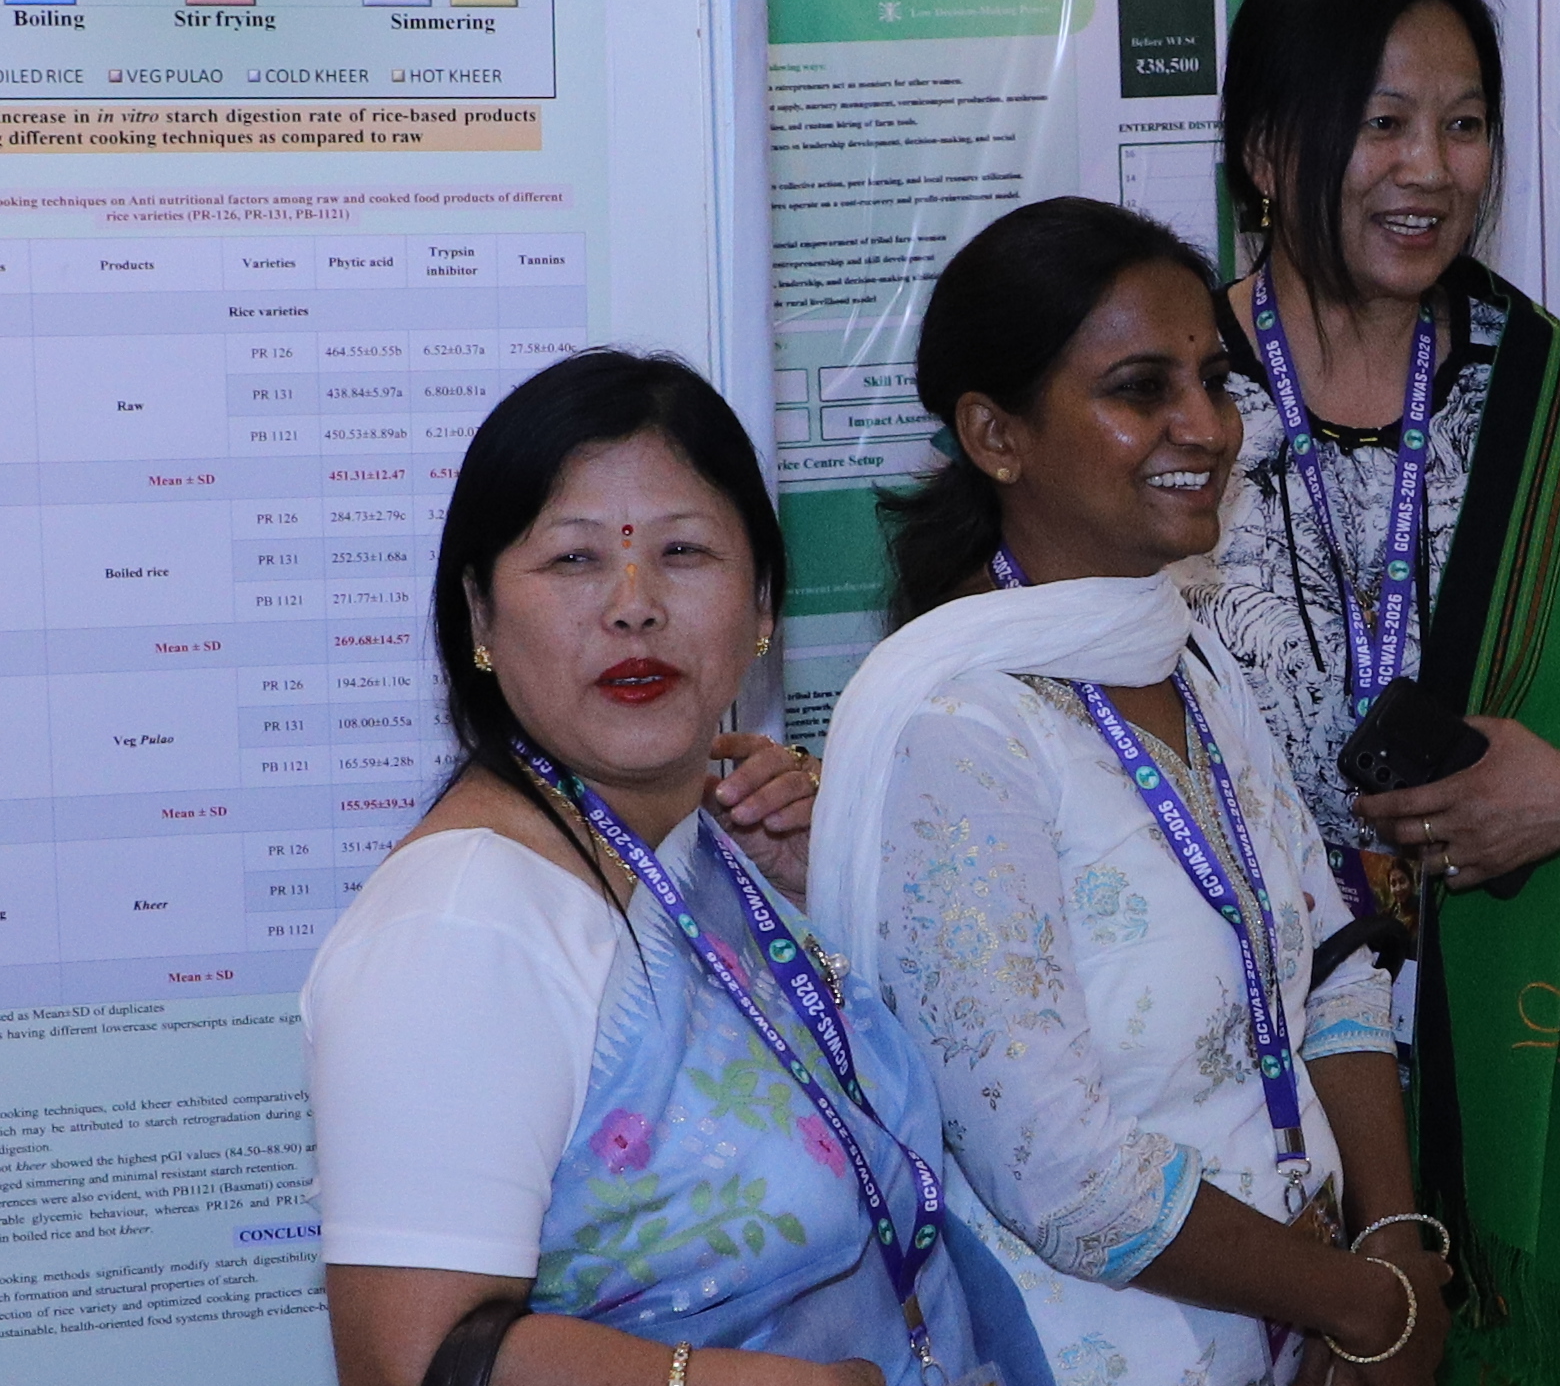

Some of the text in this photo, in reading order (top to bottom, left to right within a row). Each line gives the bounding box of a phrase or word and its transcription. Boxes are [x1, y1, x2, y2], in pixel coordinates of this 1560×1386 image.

[1265, 339, 1300, 428] GCWAS-2026
[1410, 334, 1431, 422] GCWAS-2026
[1393, 461, 1418, 552] GCWAS-2026
[1376, 592, 1403, 687] GCWAS-2026
[589, 808, 677, 906] GCWAS-2026
[1157, 800, 1225, 899] GCWAS-2026
[705, 950, 786, 1052] GCWAS-2026
[790, 973, 849, 1077] GCWAS-2026
[1242, 940, 1272, 1046] GCWAS-2026
